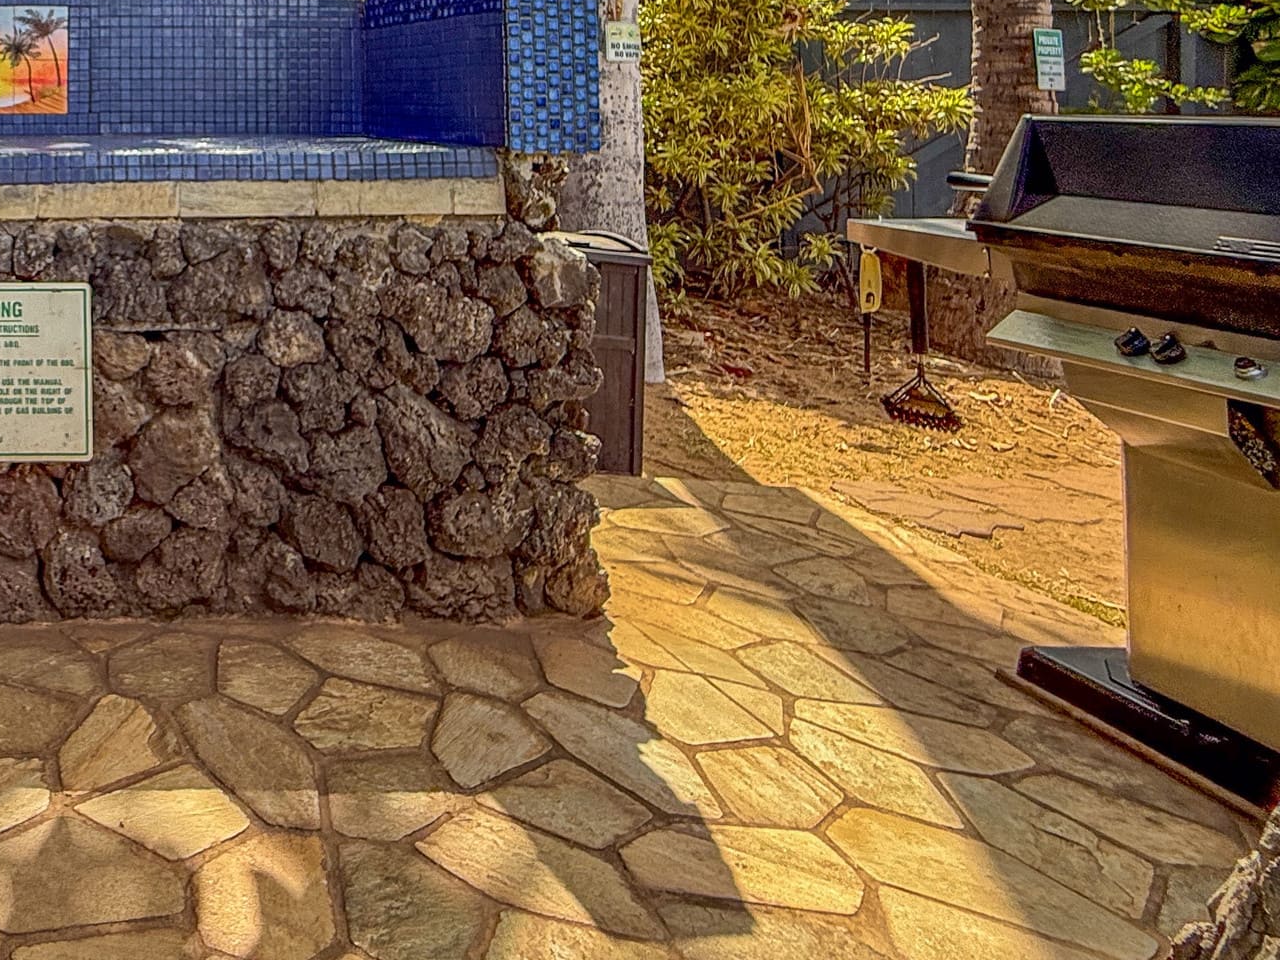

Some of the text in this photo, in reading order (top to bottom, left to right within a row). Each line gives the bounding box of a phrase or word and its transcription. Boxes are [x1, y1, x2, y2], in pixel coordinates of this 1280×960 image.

[12, 359, 34, 367] FRONT
[36, 359, 44, 367] OF
[46, 359, 58, 367] THE
